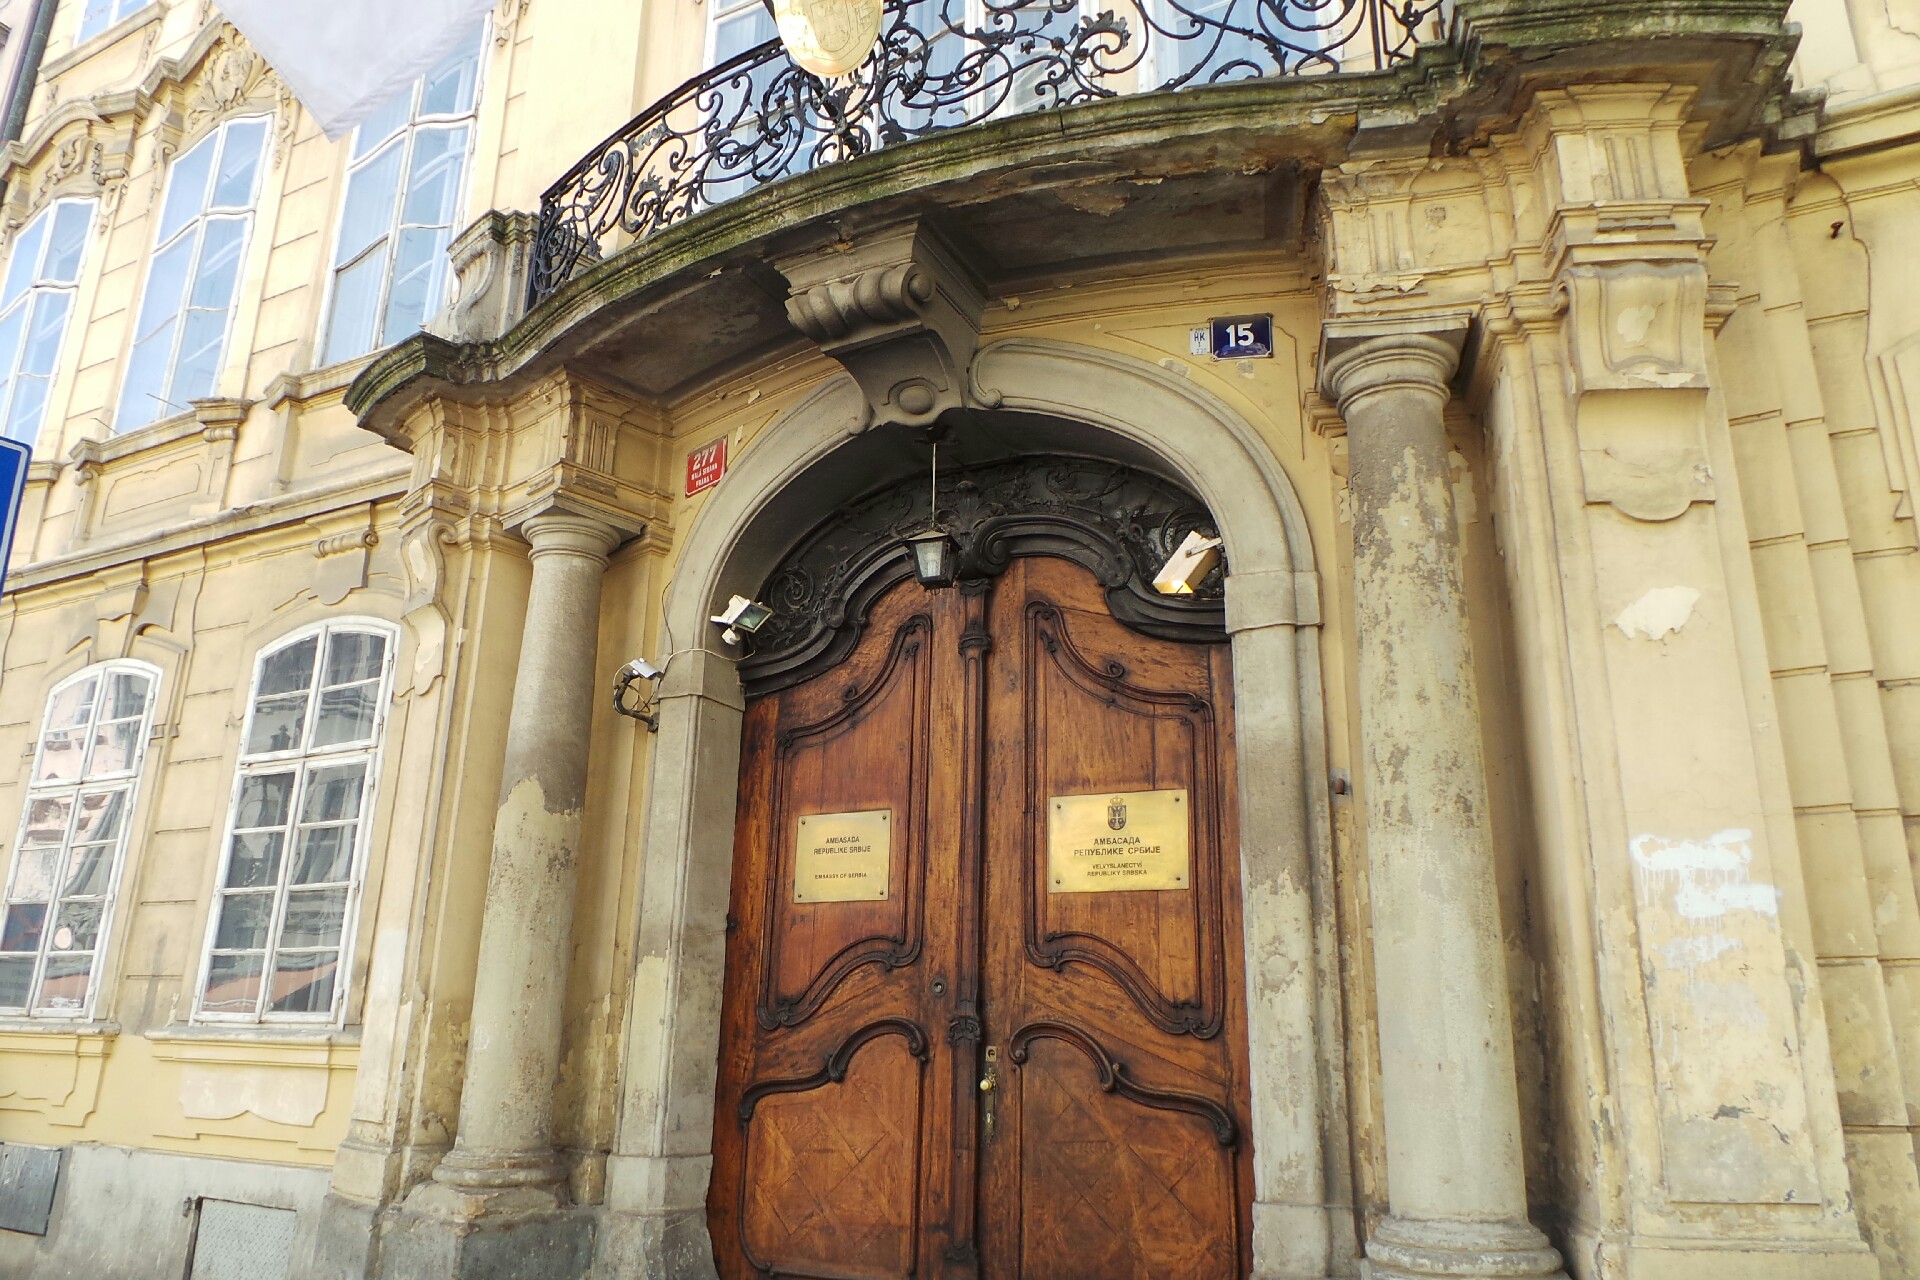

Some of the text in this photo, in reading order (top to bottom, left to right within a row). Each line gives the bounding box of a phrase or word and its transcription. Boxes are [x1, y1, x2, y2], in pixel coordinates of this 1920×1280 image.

[1225, 322, 1255, 348] 15
[693, 445, 717, 471] 277
[825, 836, 860, 844] AMBASADA
[1093, 836, 1141, 846] АМБАСАДА
[813, 845, 871, 855] REPUBLIKE SRBIJE
[1073, 846, 1161, 857] РЕПУБЛИКЕ СРБИЈЕ
